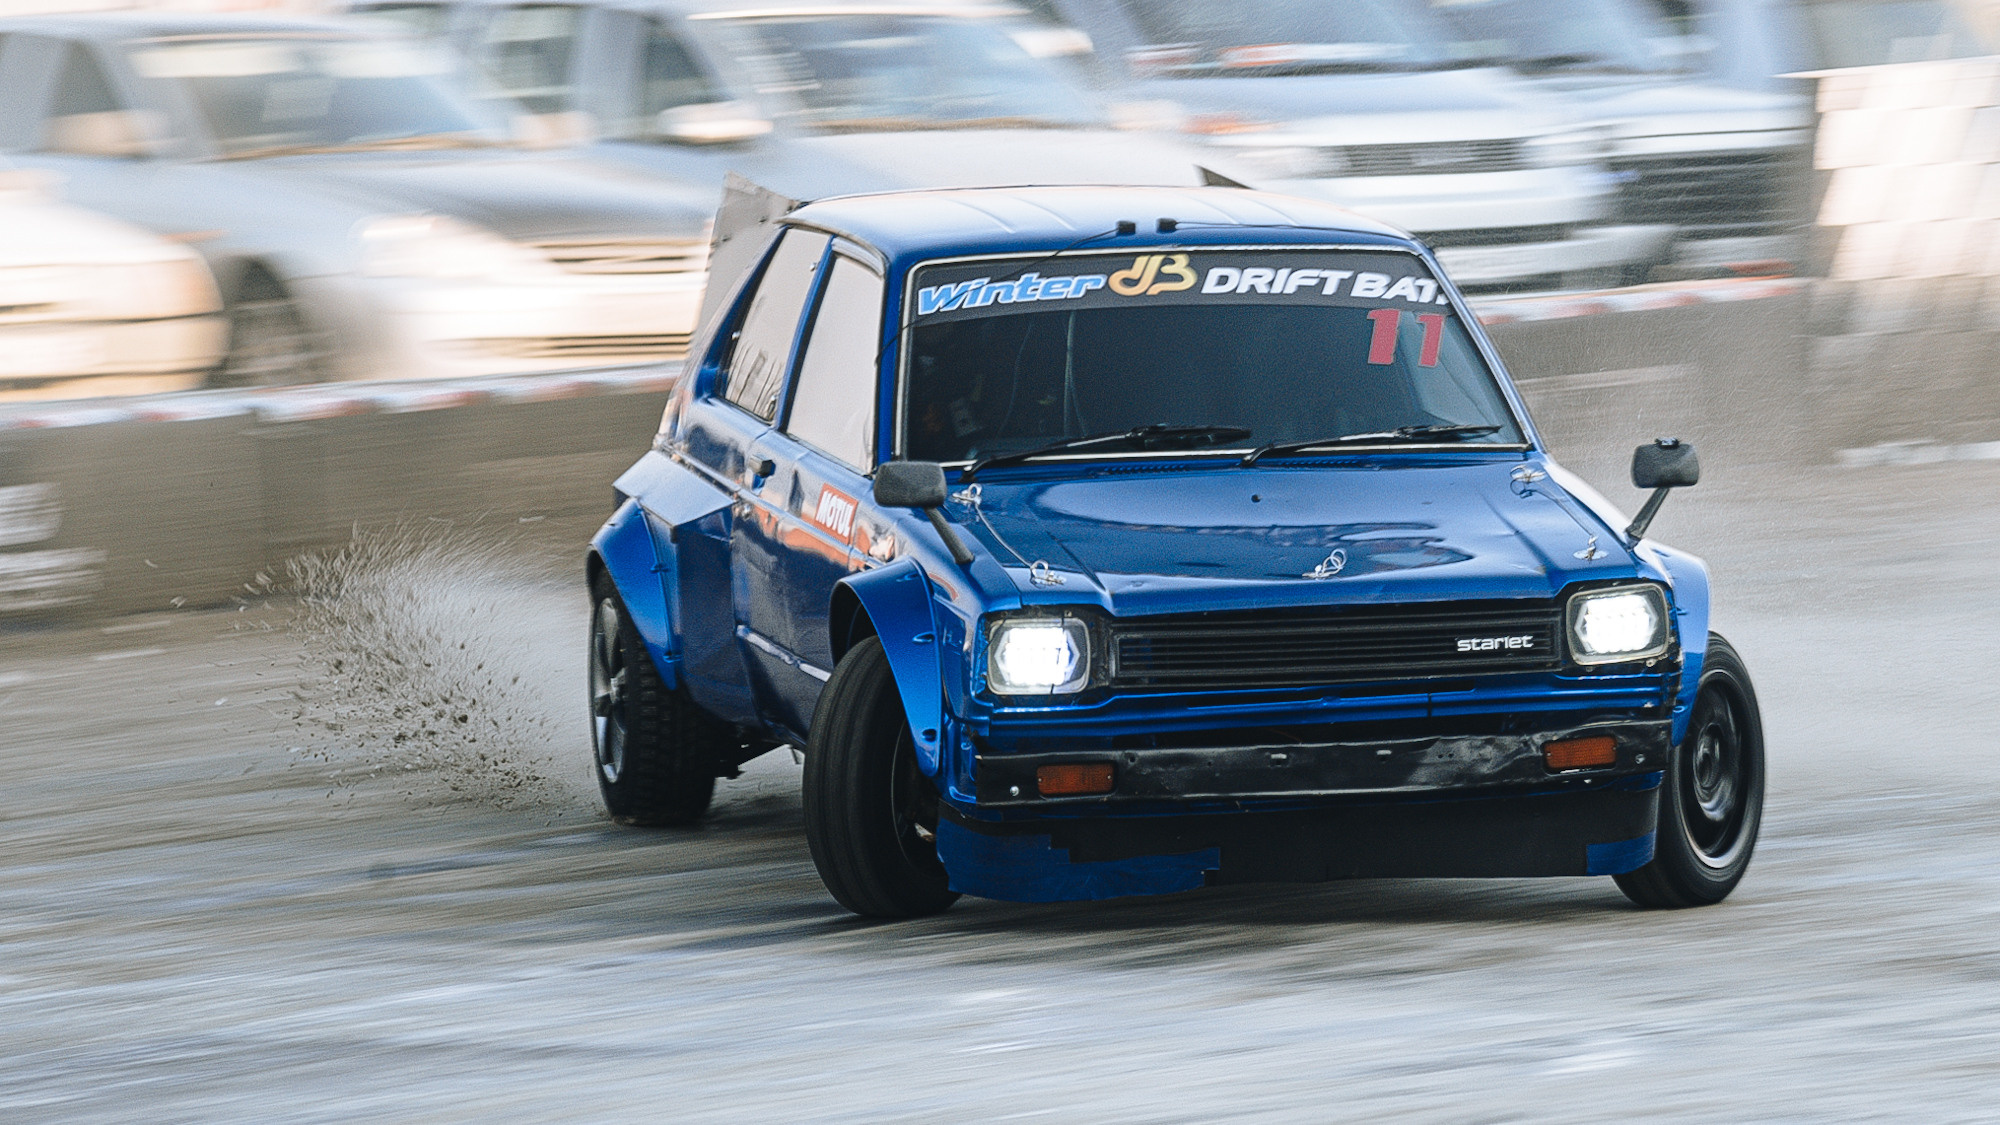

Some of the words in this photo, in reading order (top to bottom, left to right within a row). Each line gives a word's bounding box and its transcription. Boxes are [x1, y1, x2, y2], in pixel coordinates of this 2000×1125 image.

[918, 272, 1107, 315] Winter
[1201, 267, 1354, 296] DRIFT
[1367, 308, 1445, 368] 11
[816, 490, 855, 538] MOTUL
[1457, 634, 1534, 652] starlet
